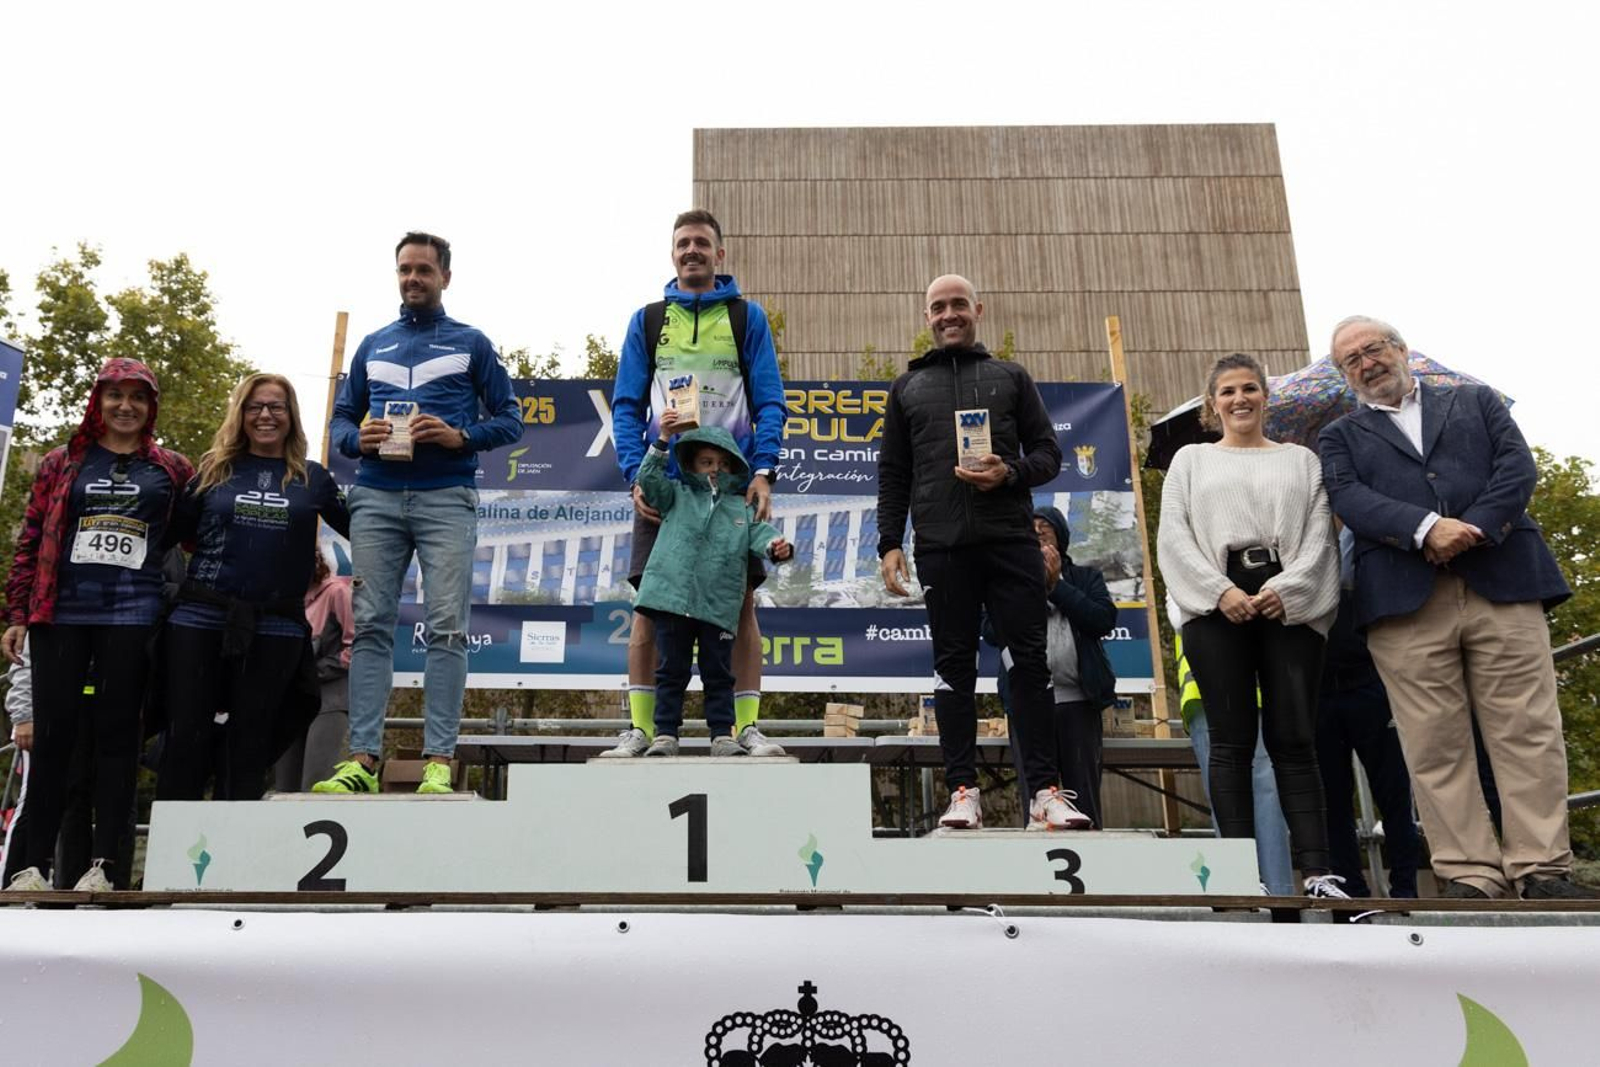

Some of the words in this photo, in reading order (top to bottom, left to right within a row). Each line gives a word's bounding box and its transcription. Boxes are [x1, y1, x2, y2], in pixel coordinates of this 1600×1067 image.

[783, 389, 889, 414] RRER
[585, 389, 617, 458] X
[783, 417, 885, 442] PULA
[778, 447, 806, 460] an
[235, 490, 290, 509] 25
[477, 504, 520, 520] alina
[527, 505, 549, 520] de
[554, 505, 633, 524] Alejandr
[88, 533, 133, 555] 496
[608, 609, 631, 645] 2
[865, 624, 934, 641] #camb
[1100, 626, 1132, 641] on
[668, 793, 708, 882] 1
[297, 819, 348, 892] 2
[1045, 848, 1086, 895] 3
